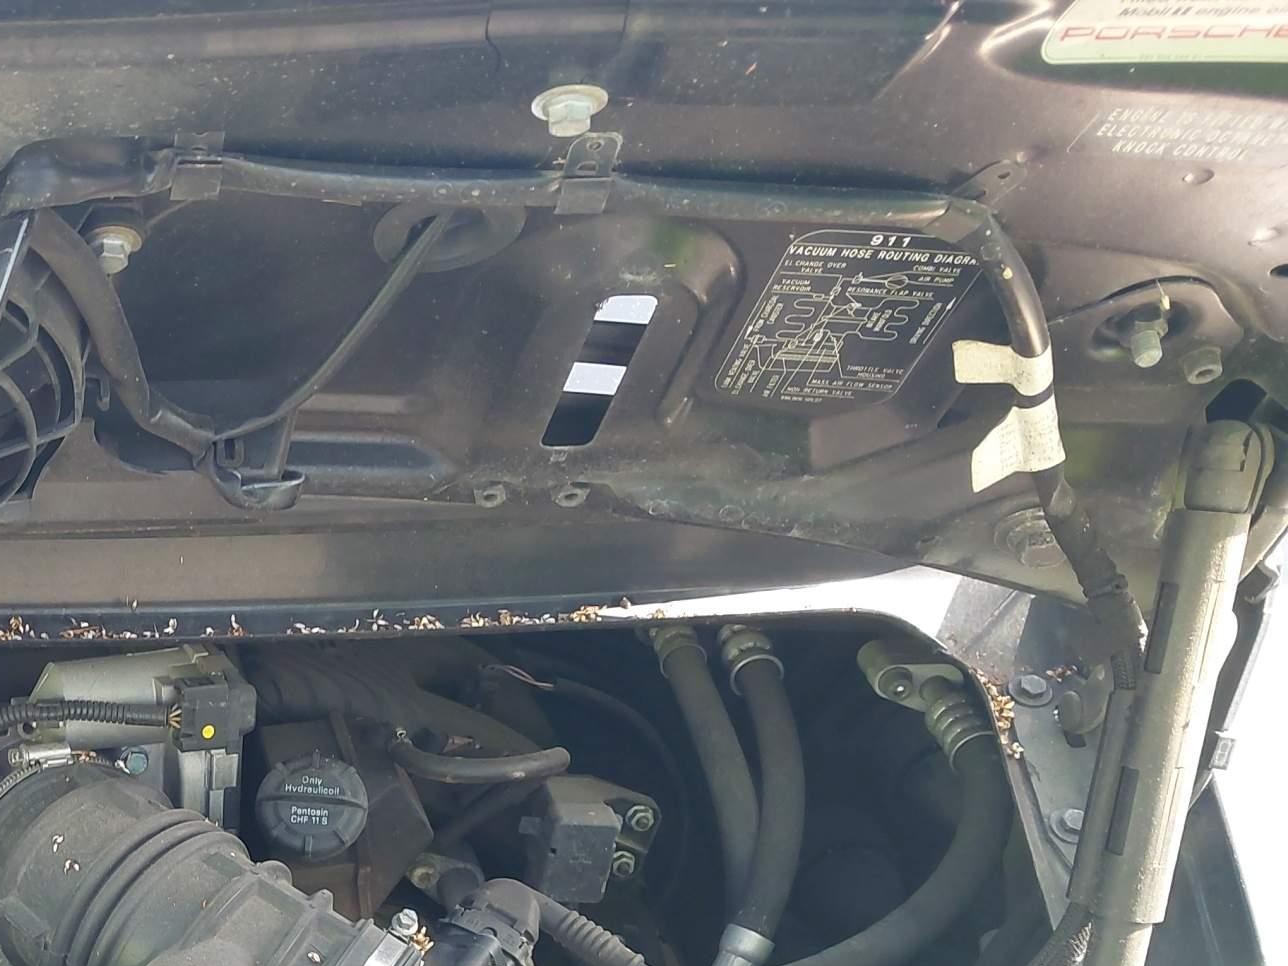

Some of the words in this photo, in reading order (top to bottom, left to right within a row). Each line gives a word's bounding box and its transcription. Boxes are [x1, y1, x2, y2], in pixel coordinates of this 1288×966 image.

[1112, 139, 1170, 155] KNOCK
[870, 234, 911, 248] 911
[788, 246, 838, 257] VACUUM
[841, 248, 873, 259] HOSE
[877, 250, 930, 263] ROUTING
[933, 255, 981, 266] DIAGRA
[302, 775, 322, 786] Only
[291, 806, 329, 817] Pentosin
[290, 815, 309, 824] CHF
